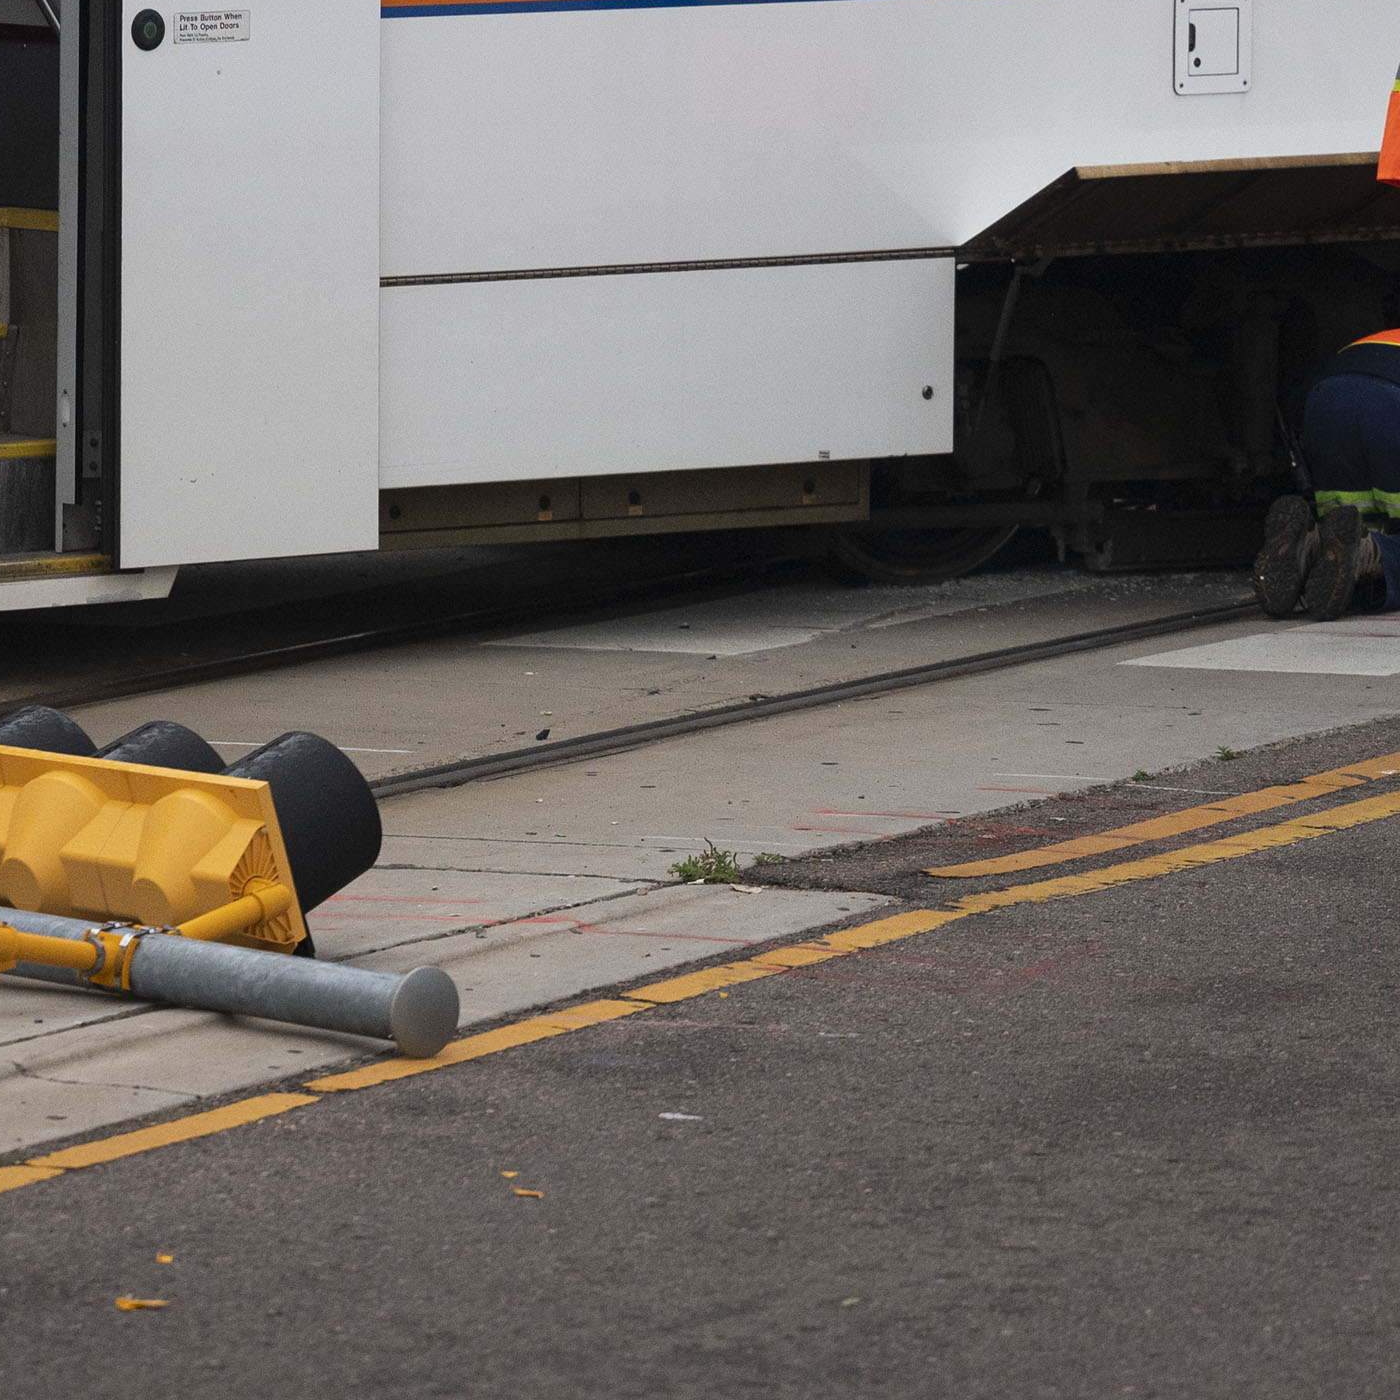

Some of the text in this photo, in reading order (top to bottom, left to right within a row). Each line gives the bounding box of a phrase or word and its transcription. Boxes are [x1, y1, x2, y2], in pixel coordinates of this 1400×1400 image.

[224, 12, 243, 20] When
[179, 23, 188, 31] Lit
[190, 23, 198, 31] To
[200, 22, 218, 31] Open
